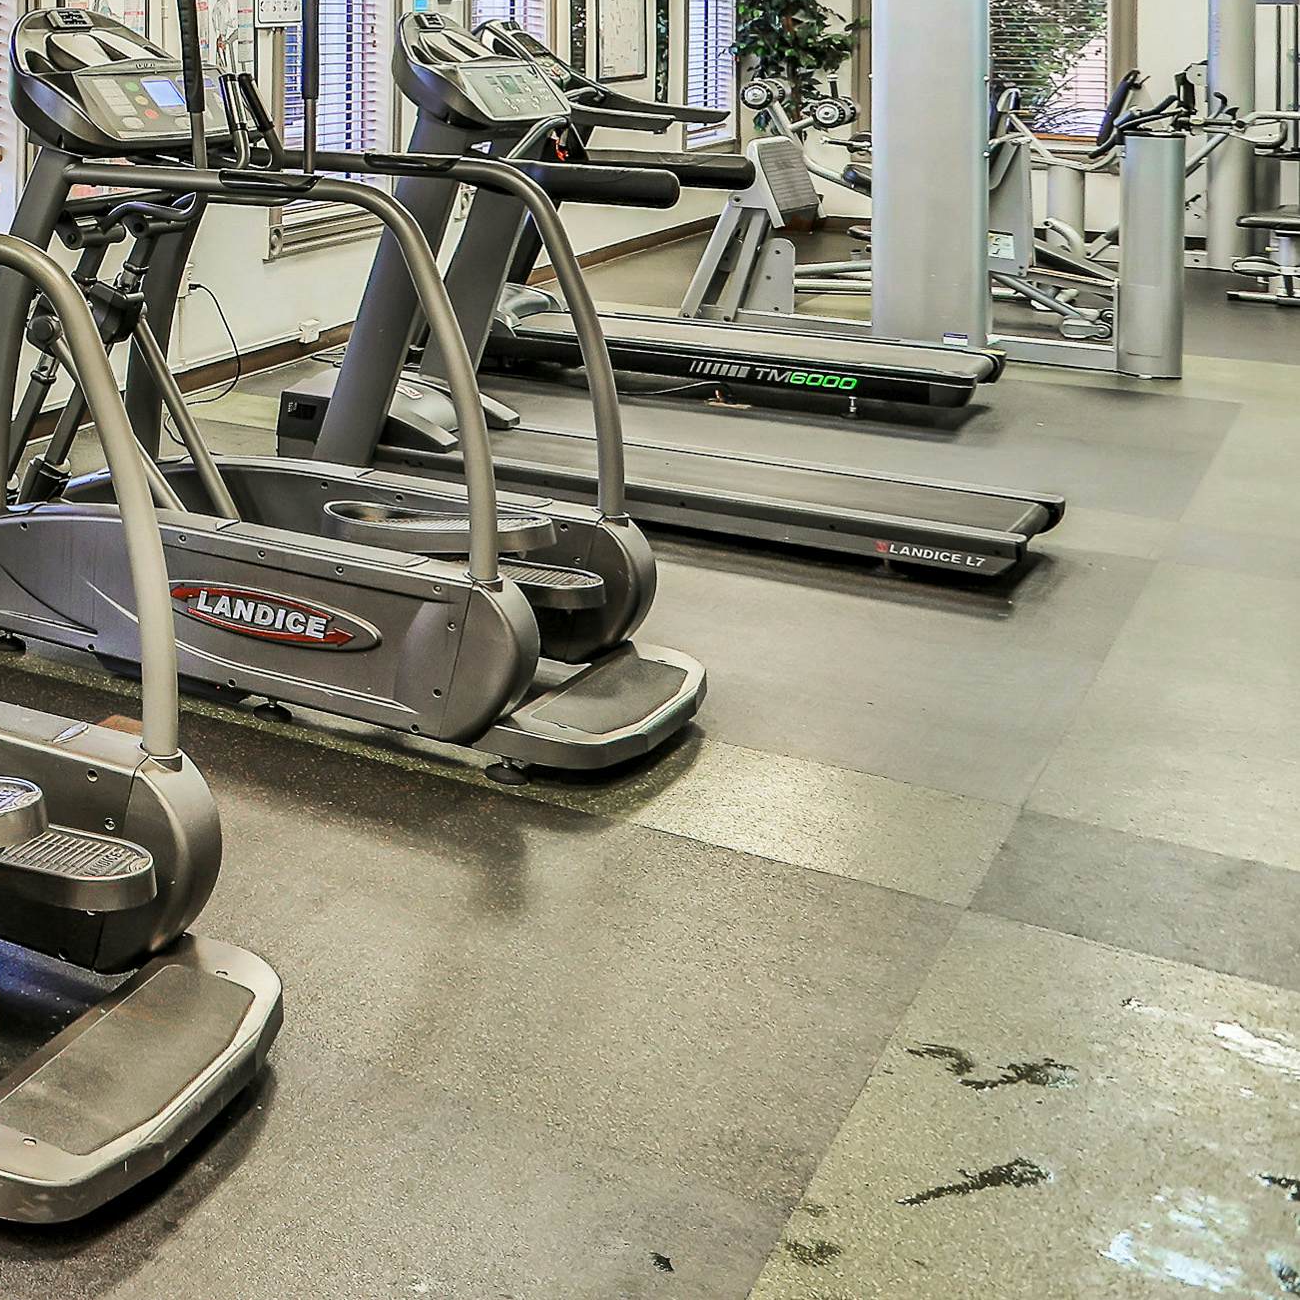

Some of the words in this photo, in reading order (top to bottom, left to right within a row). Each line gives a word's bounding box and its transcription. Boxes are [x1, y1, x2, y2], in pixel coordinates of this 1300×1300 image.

[755, 367, 858, 390] TM6000
[889, 543, 962, 564] LANDICE
[966, 557, 986, 567] L7
[196, 590, 328, 639] LANDICE
